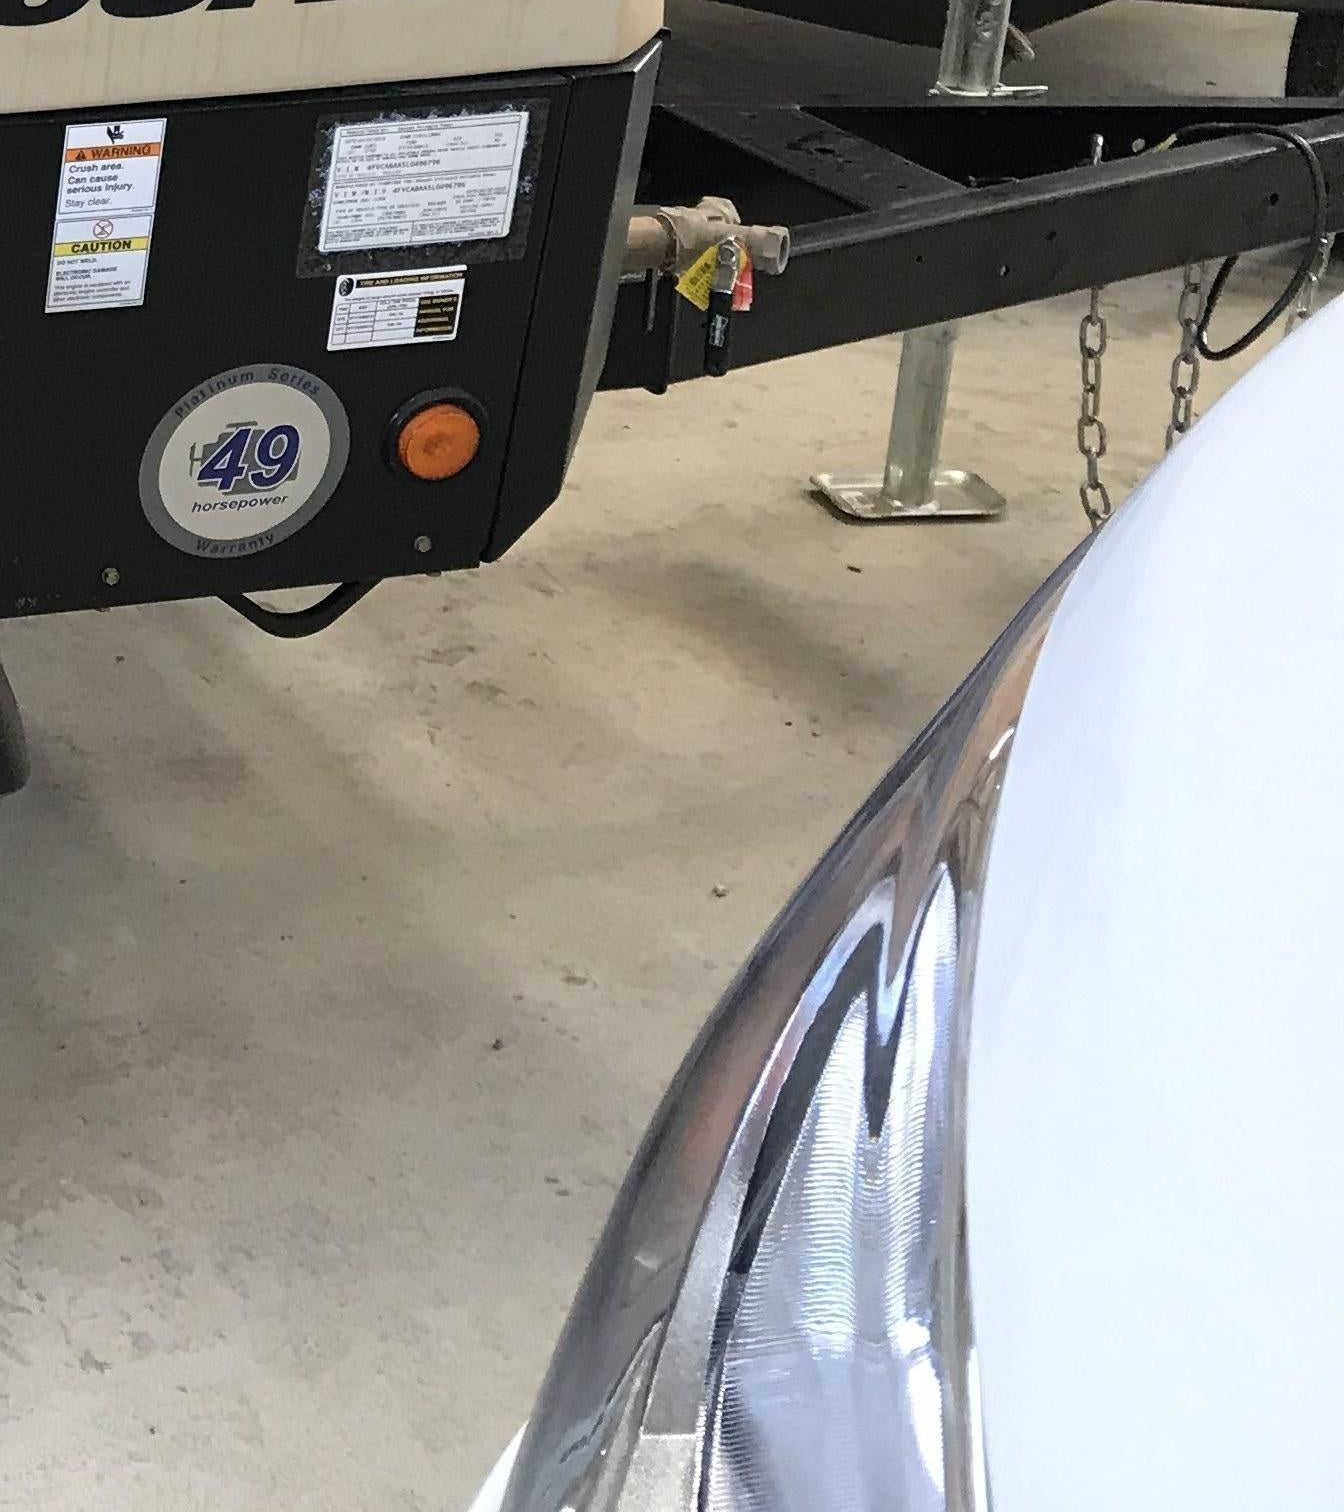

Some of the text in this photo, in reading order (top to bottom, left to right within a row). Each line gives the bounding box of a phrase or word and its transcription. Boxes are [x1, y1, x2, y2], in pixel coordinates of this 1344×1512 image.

[91, 145, 151, 159] WARNING
[69, 163, 124, 173] Crush area.
[68, 174, 118, 185] Can cause
[67, 184, 102, 194] serious
[65, 197, 112, 208] Stay clear.
[72, 240, 131, 254] CAUTION
[174, 368, 321, 419] Platinum Series
[197, 425, 301, 491] 49
[192, 494, 289, 513] horsepower
[195, 533, 274, 553] Warranty
